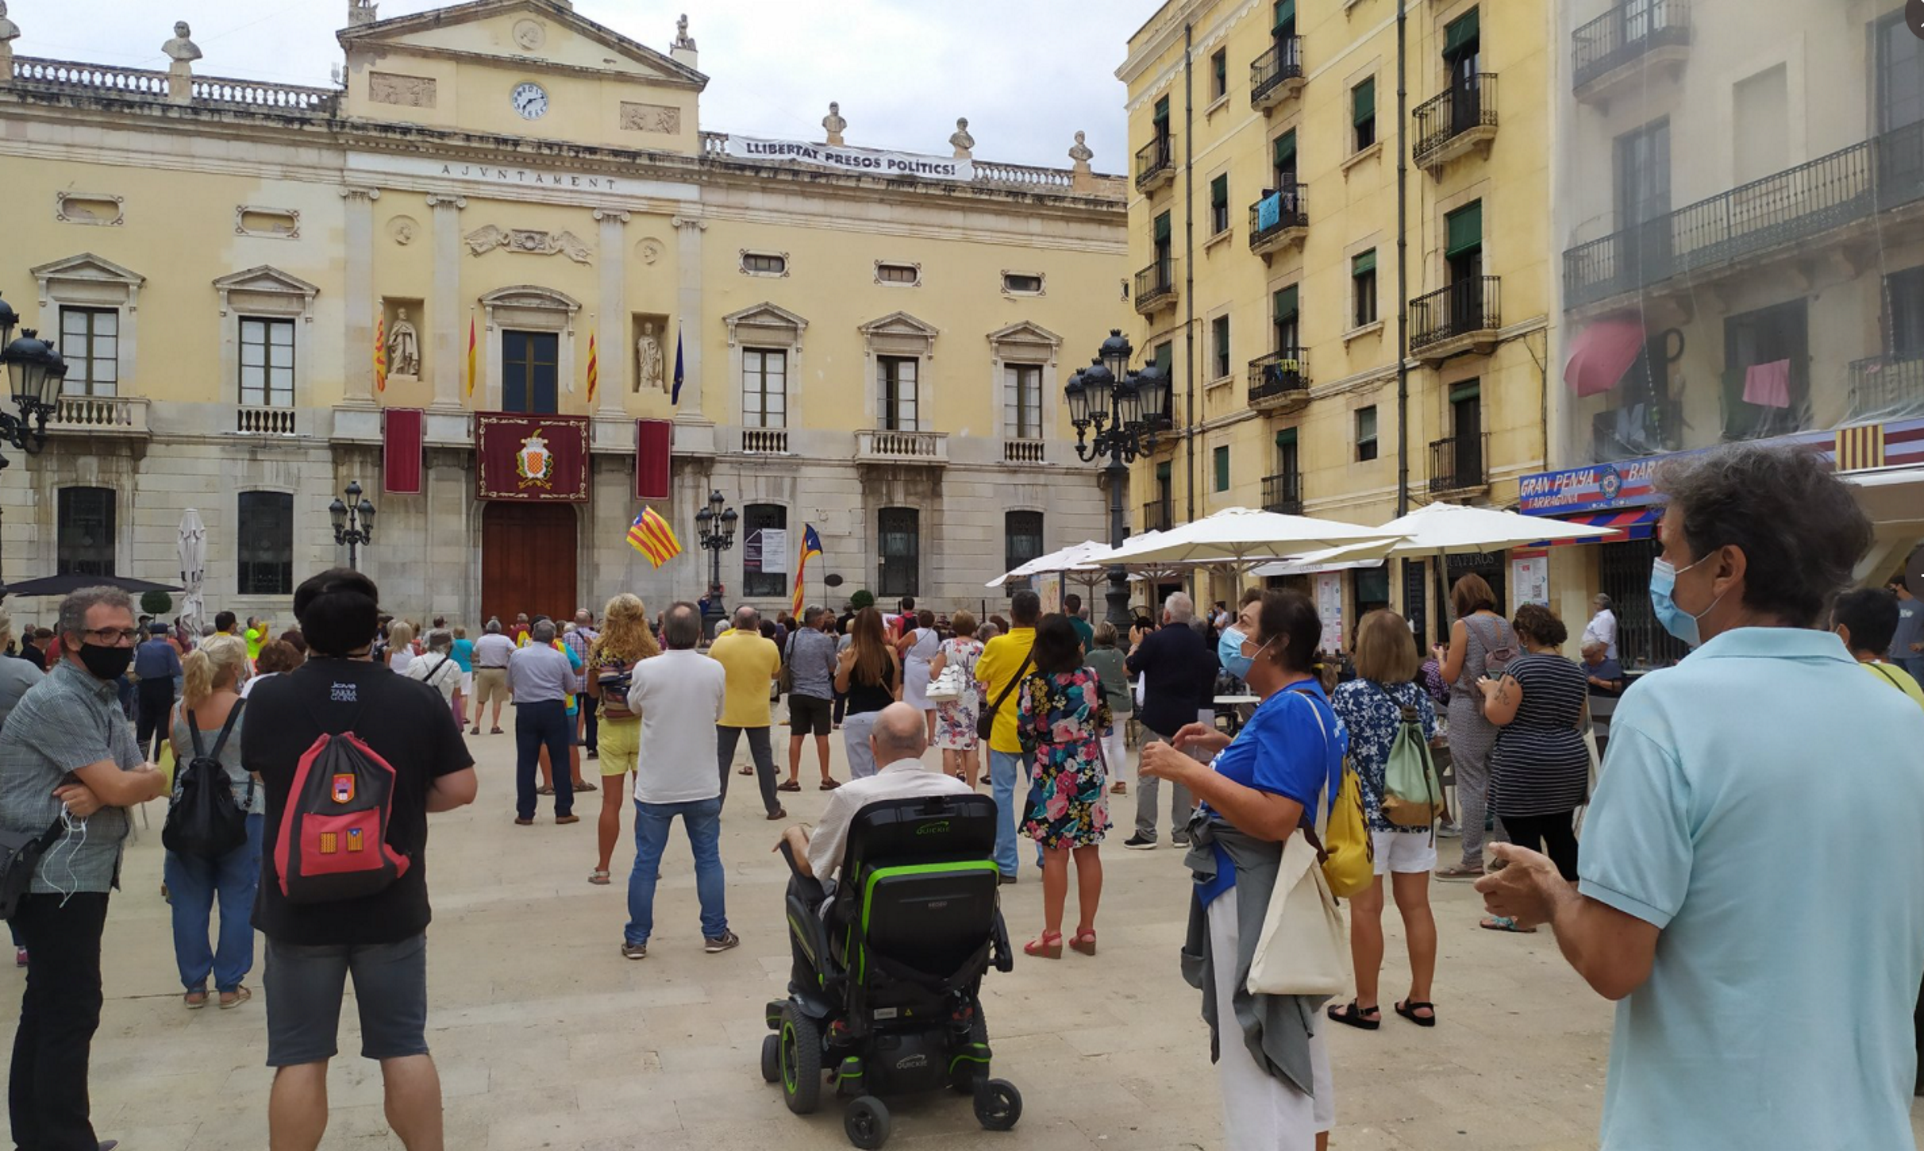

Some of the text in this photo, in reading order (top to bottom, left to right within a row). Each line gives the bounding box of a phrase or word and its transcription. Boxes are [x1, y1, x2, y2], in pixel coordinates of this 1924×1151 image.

[746, 142, 956, 175] LLIBERTAT PRESOS POLÍTICS!
[442, 164, 616, 190] AJVNTAMENT
[1520, 476, 1550, 497] GRAN
[1554, 469, 1595, 492] PENYA
[1628, 462, 1662, 481] BAR
